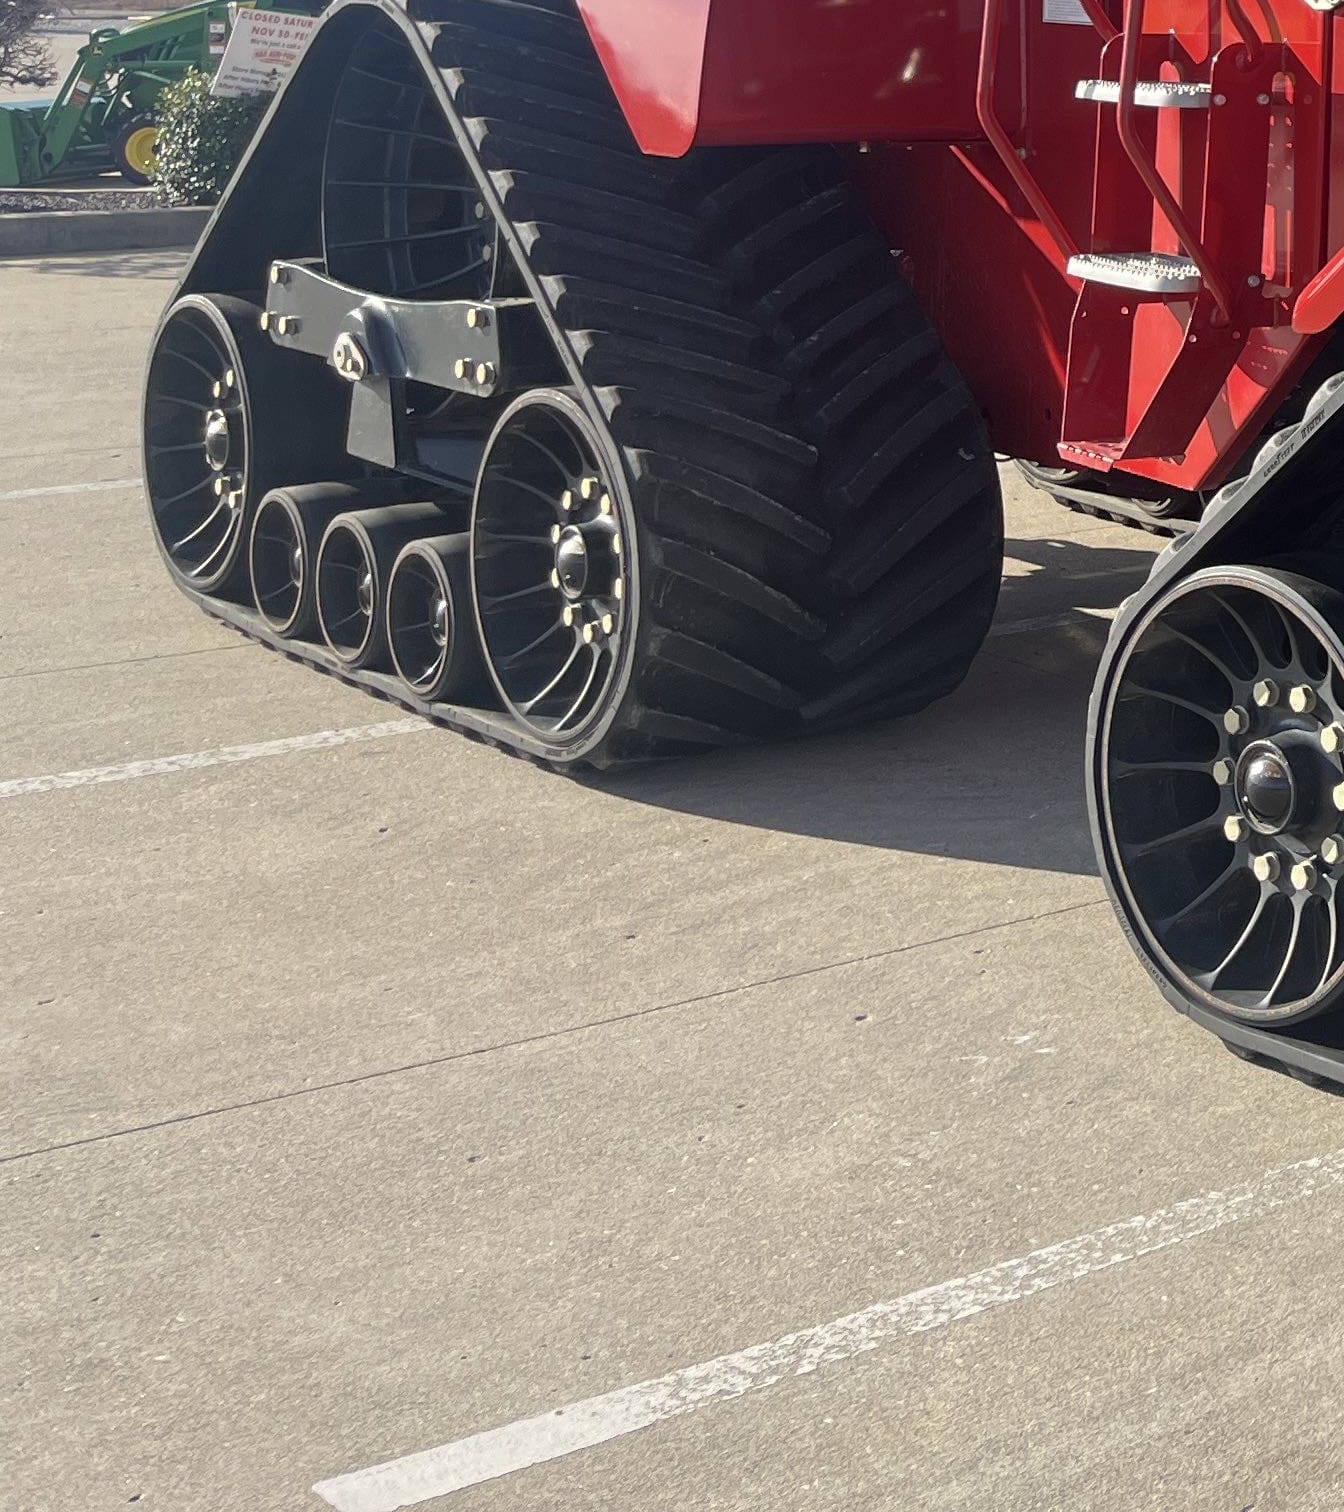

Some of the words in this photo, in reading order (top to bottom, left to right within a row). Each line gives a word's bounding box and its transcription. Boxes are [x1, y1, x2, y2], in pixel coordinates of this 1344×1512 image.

[241, 11, 281, 25] CLOSED
[283, 16, 314, 29] SATUR
[251, 27, 275, 38] NOV
